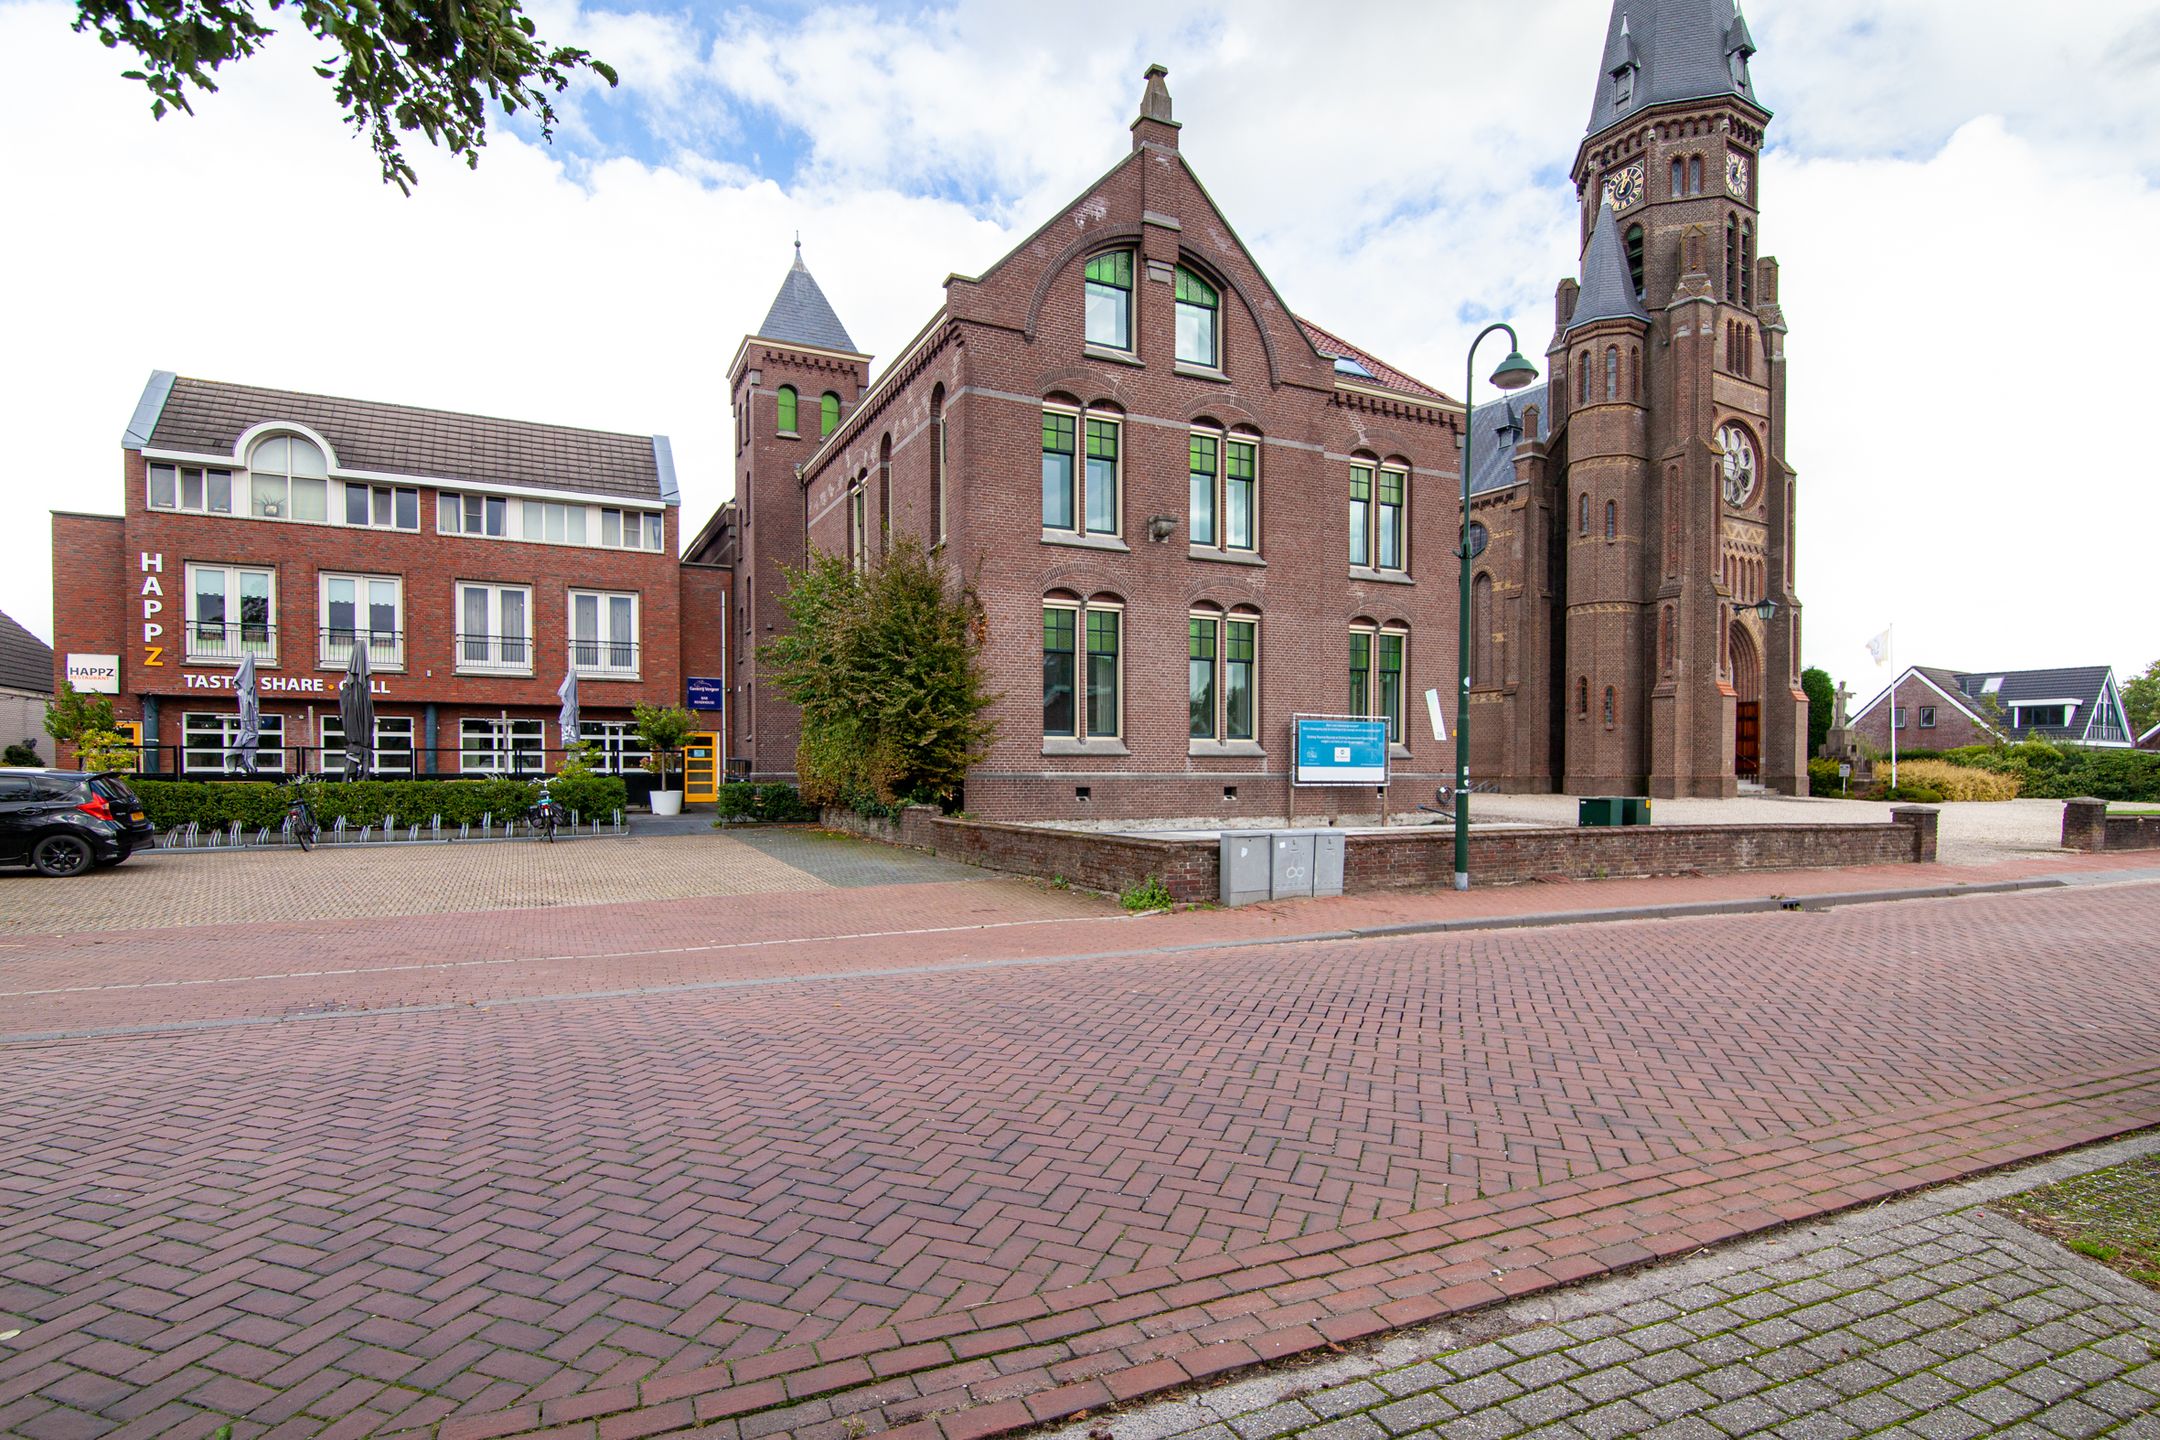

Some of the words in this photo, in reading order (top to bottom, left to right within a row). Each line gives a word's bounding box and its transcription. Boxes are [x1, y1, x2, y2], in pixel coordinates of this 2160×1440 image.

[141, 552, 163, 667] HAPPZ
[69, 667, 114, 677] HAPPZ
[183, 674, 237, 689] TAST
[260, 677, 324, 692] SHARE
